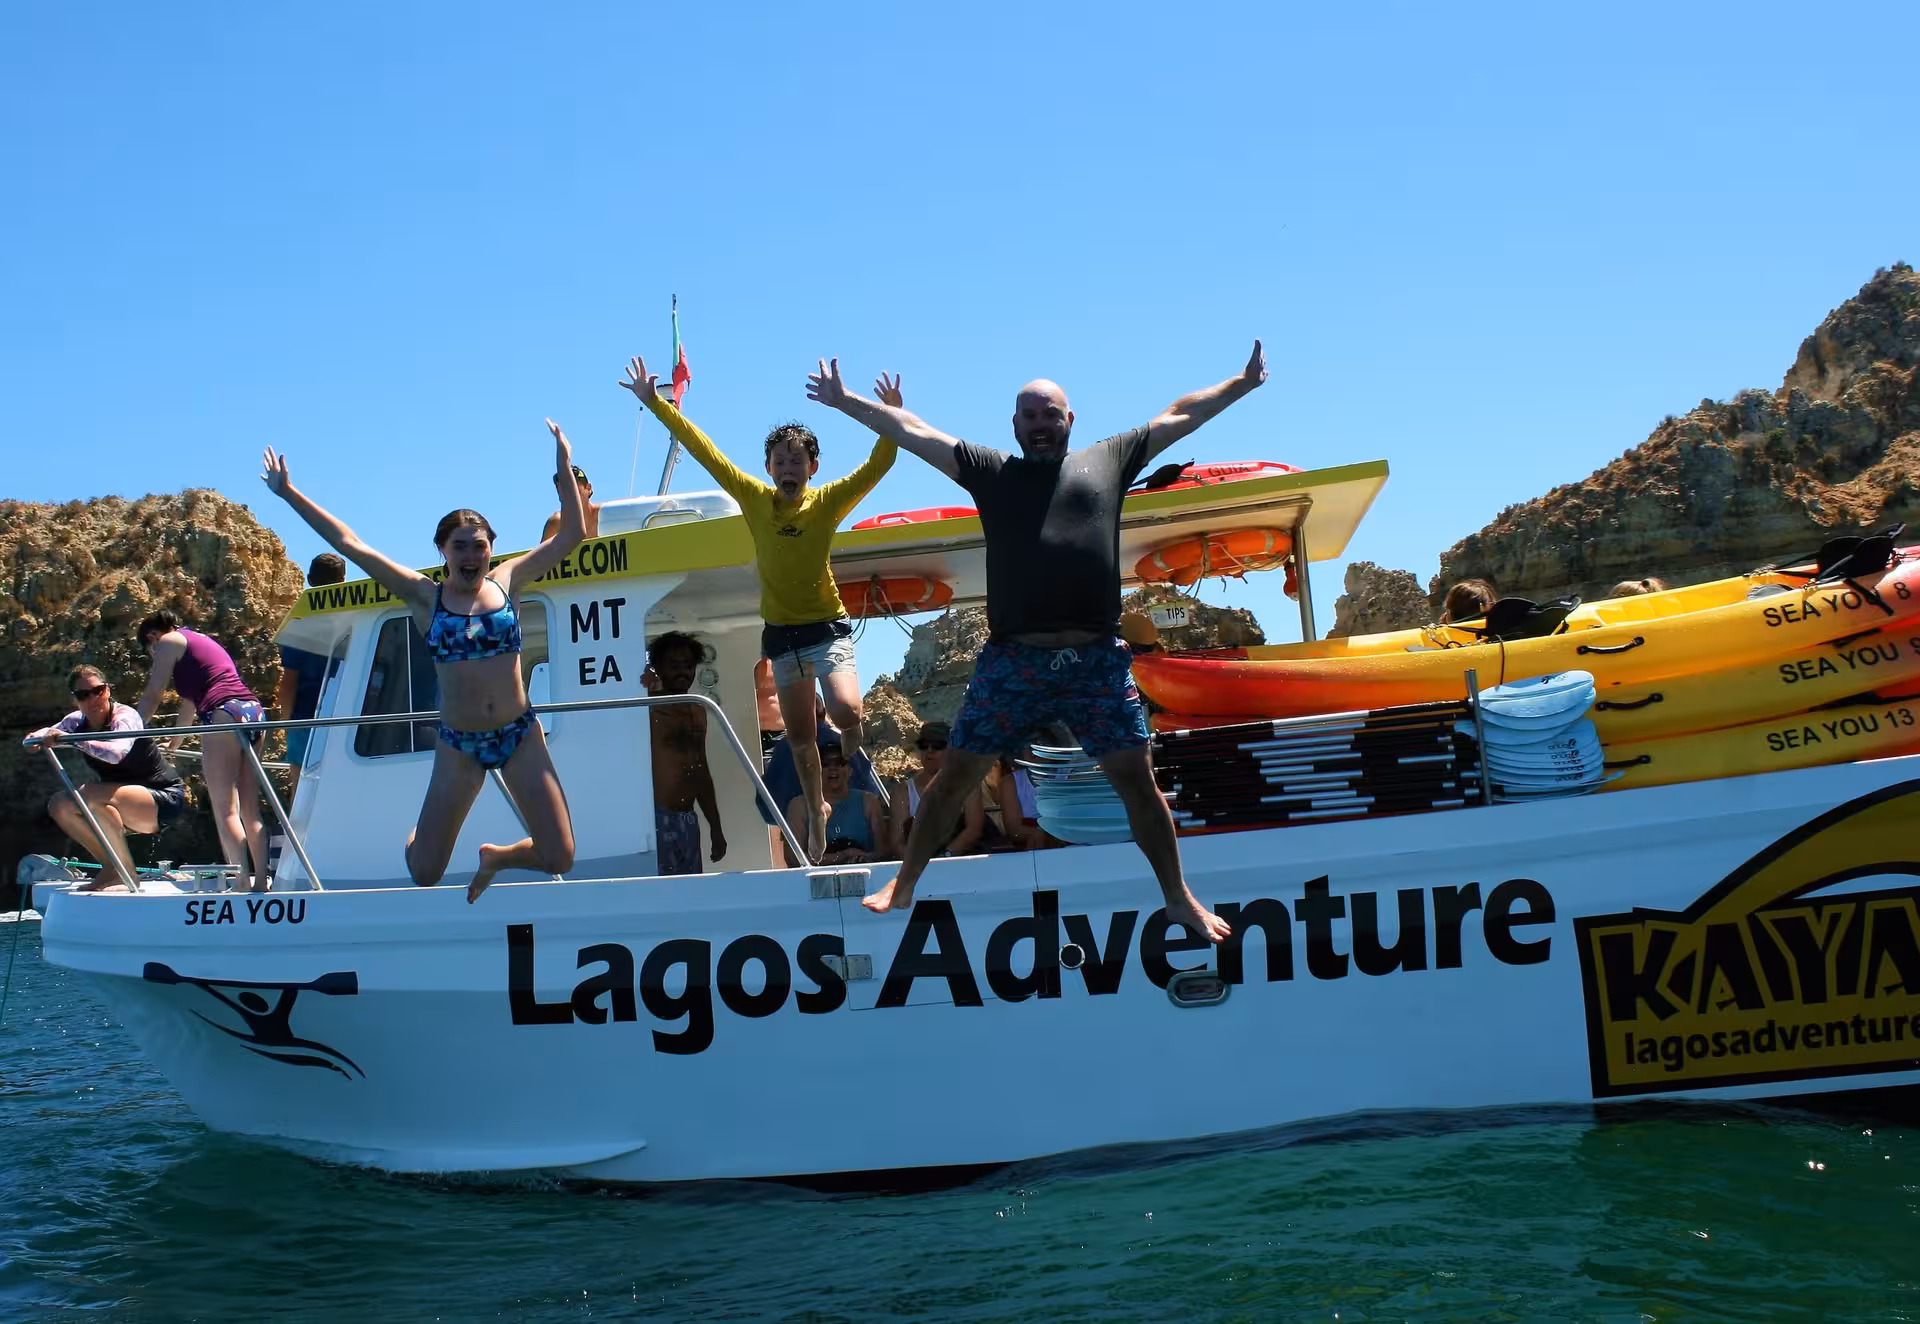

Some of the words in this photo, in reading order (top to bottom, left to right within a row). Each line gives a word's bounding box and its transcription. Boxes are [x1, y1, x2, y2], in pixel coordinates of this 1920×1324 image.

[570, 598, 626, 643] MT
[1166, 607, 1185, 620] TIPS
[1763, 601, 1821, 627] SEA
[1822, 586, 1880, 612] YO
[1893, 582, 1911, 601] 8
[579, 655, 622, 686] EA
[1779, 657, 1839, 684] SEA
[1838, 642, 1900, 670] YOU
[1766, 726, 1821, 752] SEA
[1822, 713, 1880, 740] YOU
[1884, 708, 1915, 729] 13
[184, 900, 235, 926] SEA
[246, 898, 307, 925] YOU
[506, 922, 848, 1056] Lagos
[875, 875, 1556, 1008] Adventure
